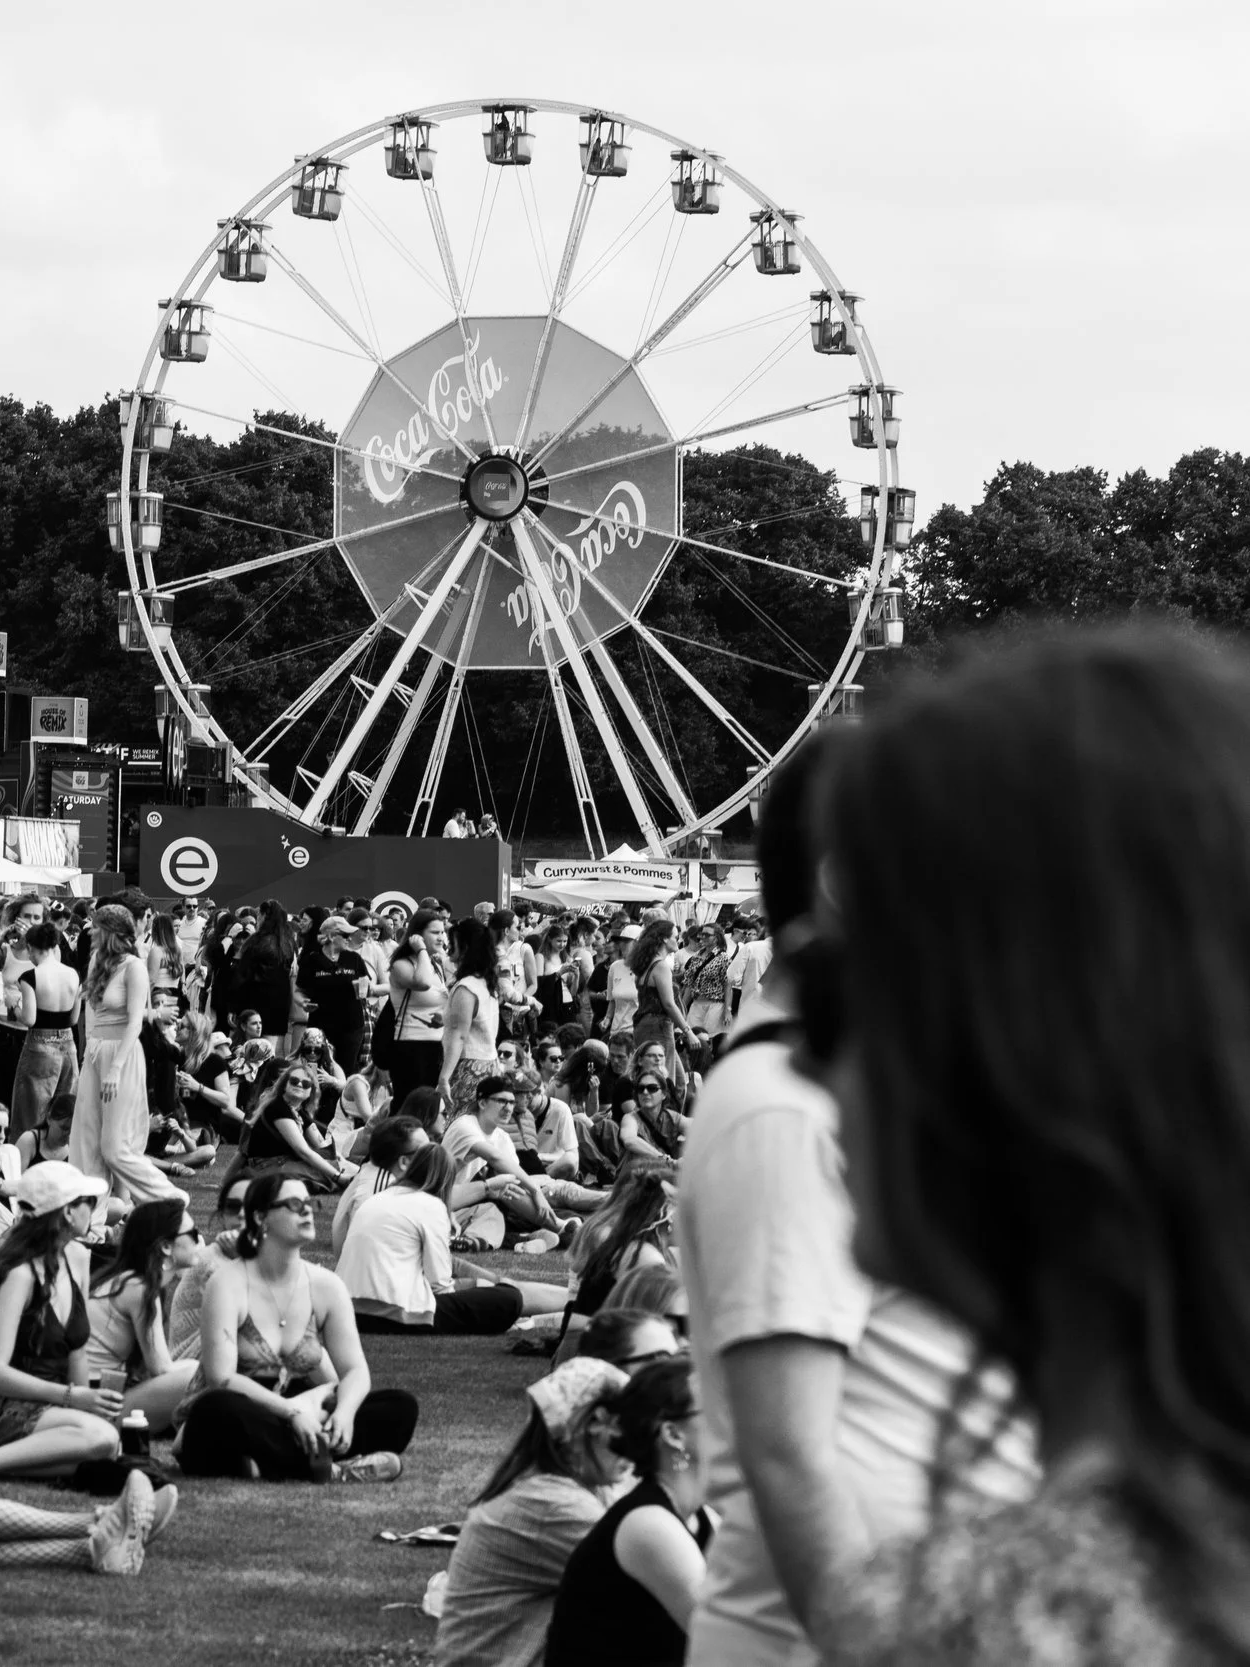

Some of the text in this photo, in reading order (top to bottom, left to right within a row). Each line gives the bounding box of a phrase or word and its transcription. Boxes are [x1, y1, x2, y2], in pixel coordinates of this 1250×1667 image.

[507, 480, 647, 657] CocaCla
[39, 715, 67, 732] REMIX
[167, 844, 212, 888] e
[290, 848, 308, 866] e
[543, 866, 610, 878] Currywurst
[623, 867, 673, 880] Pommes
